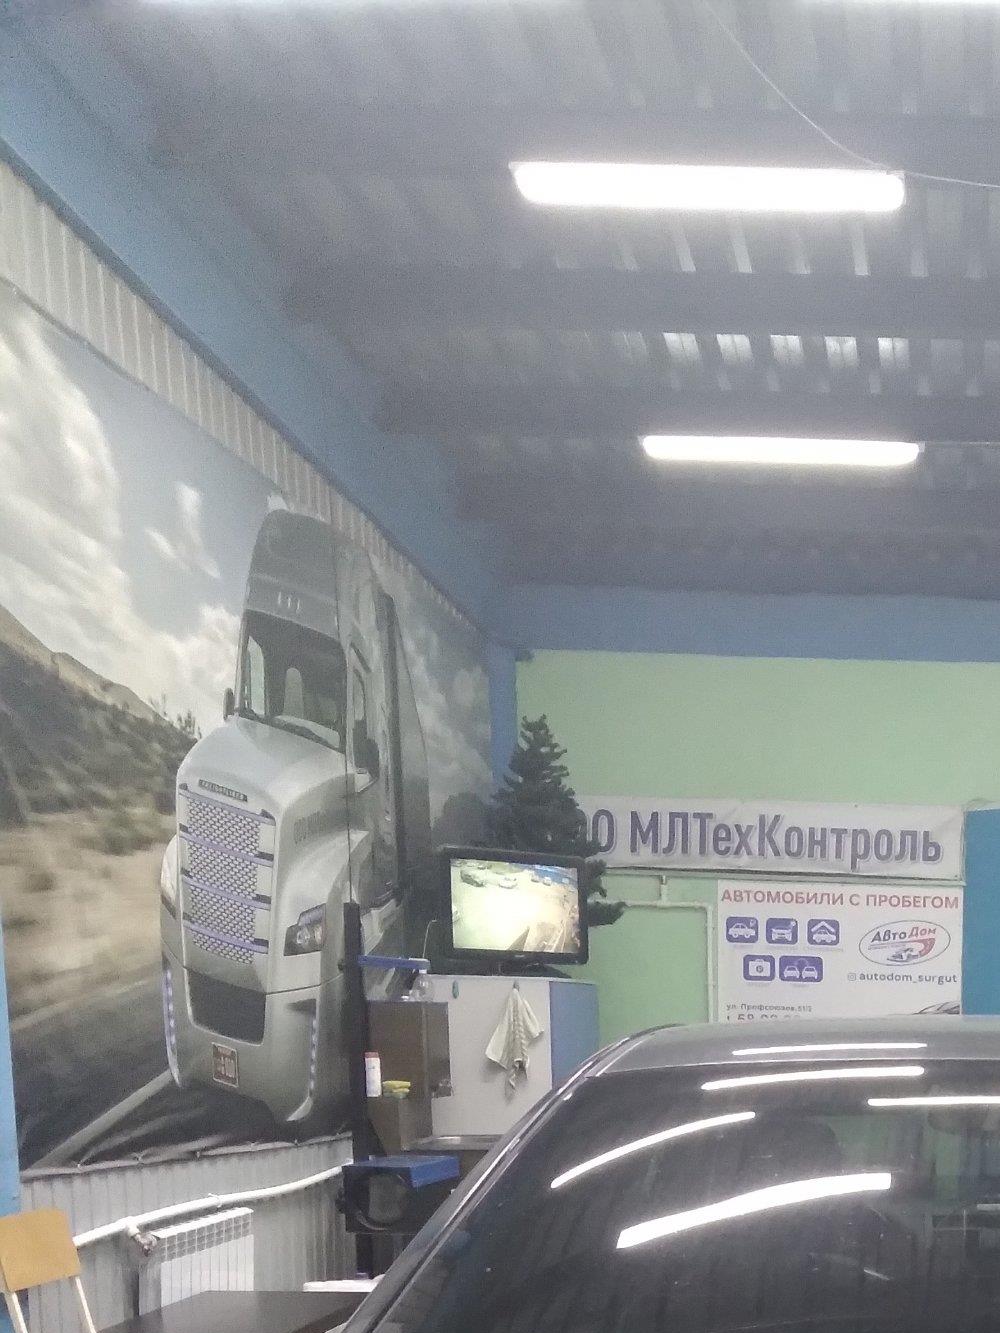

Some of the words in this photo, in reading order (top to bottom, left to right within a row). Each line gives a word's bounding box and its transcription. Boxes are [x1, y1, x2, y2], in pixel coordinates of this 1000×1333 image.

[629, 810, 943, 873] МЛТехКонтроль
[721, 889, 844, 905] АВТОМОБИЛИ
[849, 893, 860, 906] С
[866, 893, 959, 909] ПРОБЕГОМ
[858, 973, 958, 986] autodom_surgut
